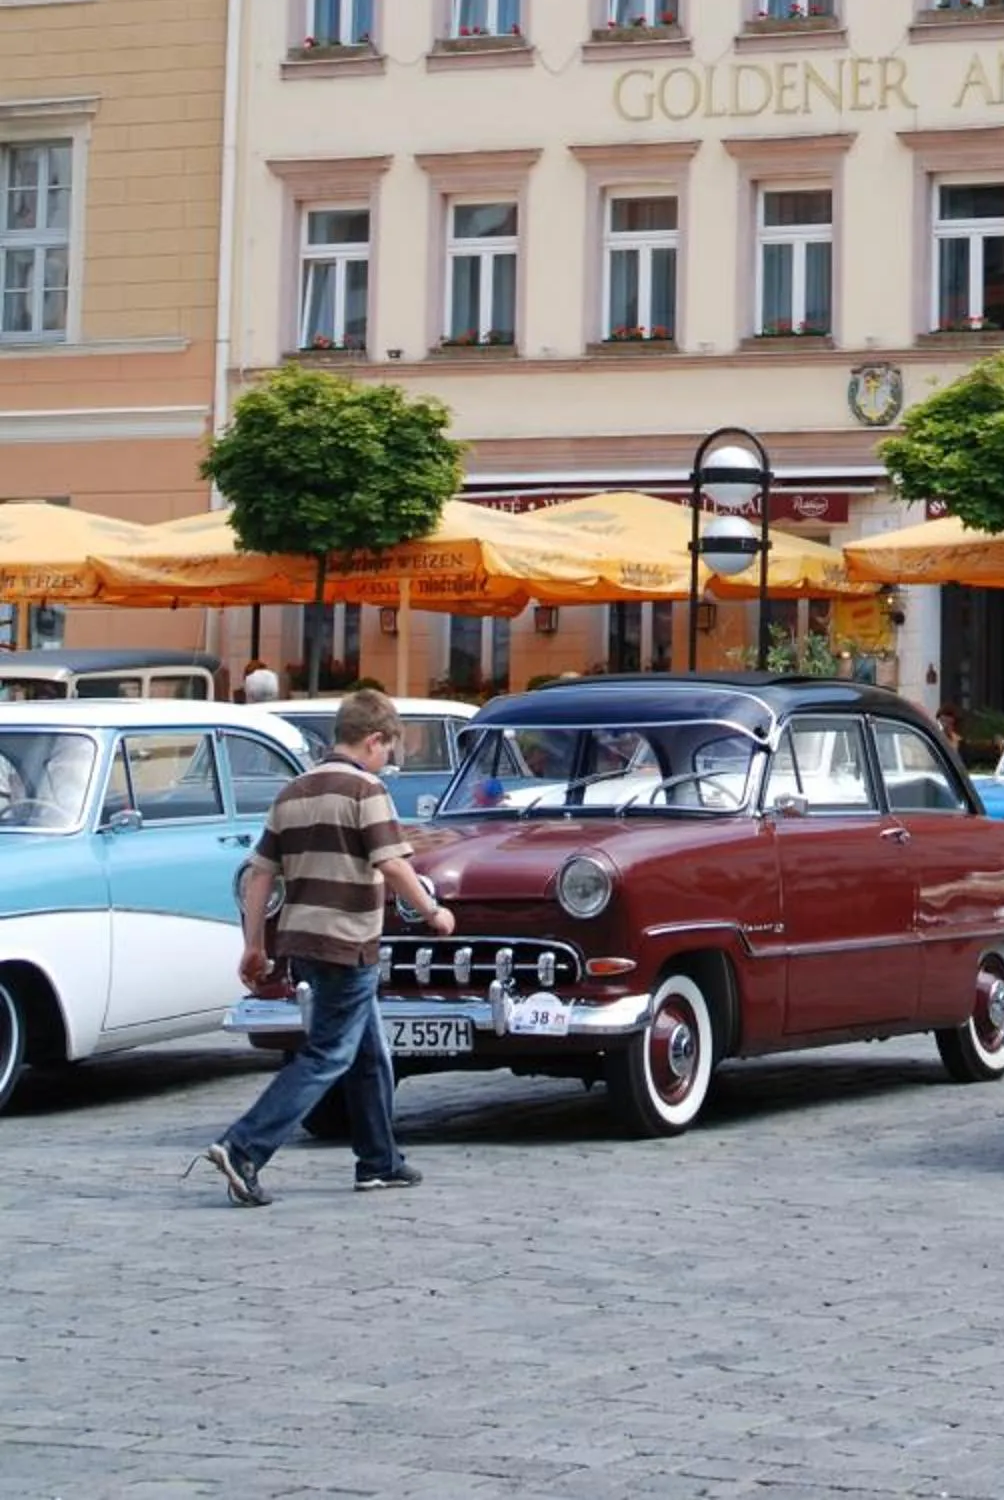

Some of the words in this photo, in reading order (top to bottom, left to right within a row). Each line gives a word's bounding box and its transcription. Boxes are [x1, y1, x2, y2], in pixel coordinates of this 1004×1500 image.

[611, 56, 917, 123] GOLDENER
[399, 553, 463, 569] WEIZEN
[531, 1010, 549, 1025] 38
[411, 1020, 471, 1048] 557H
